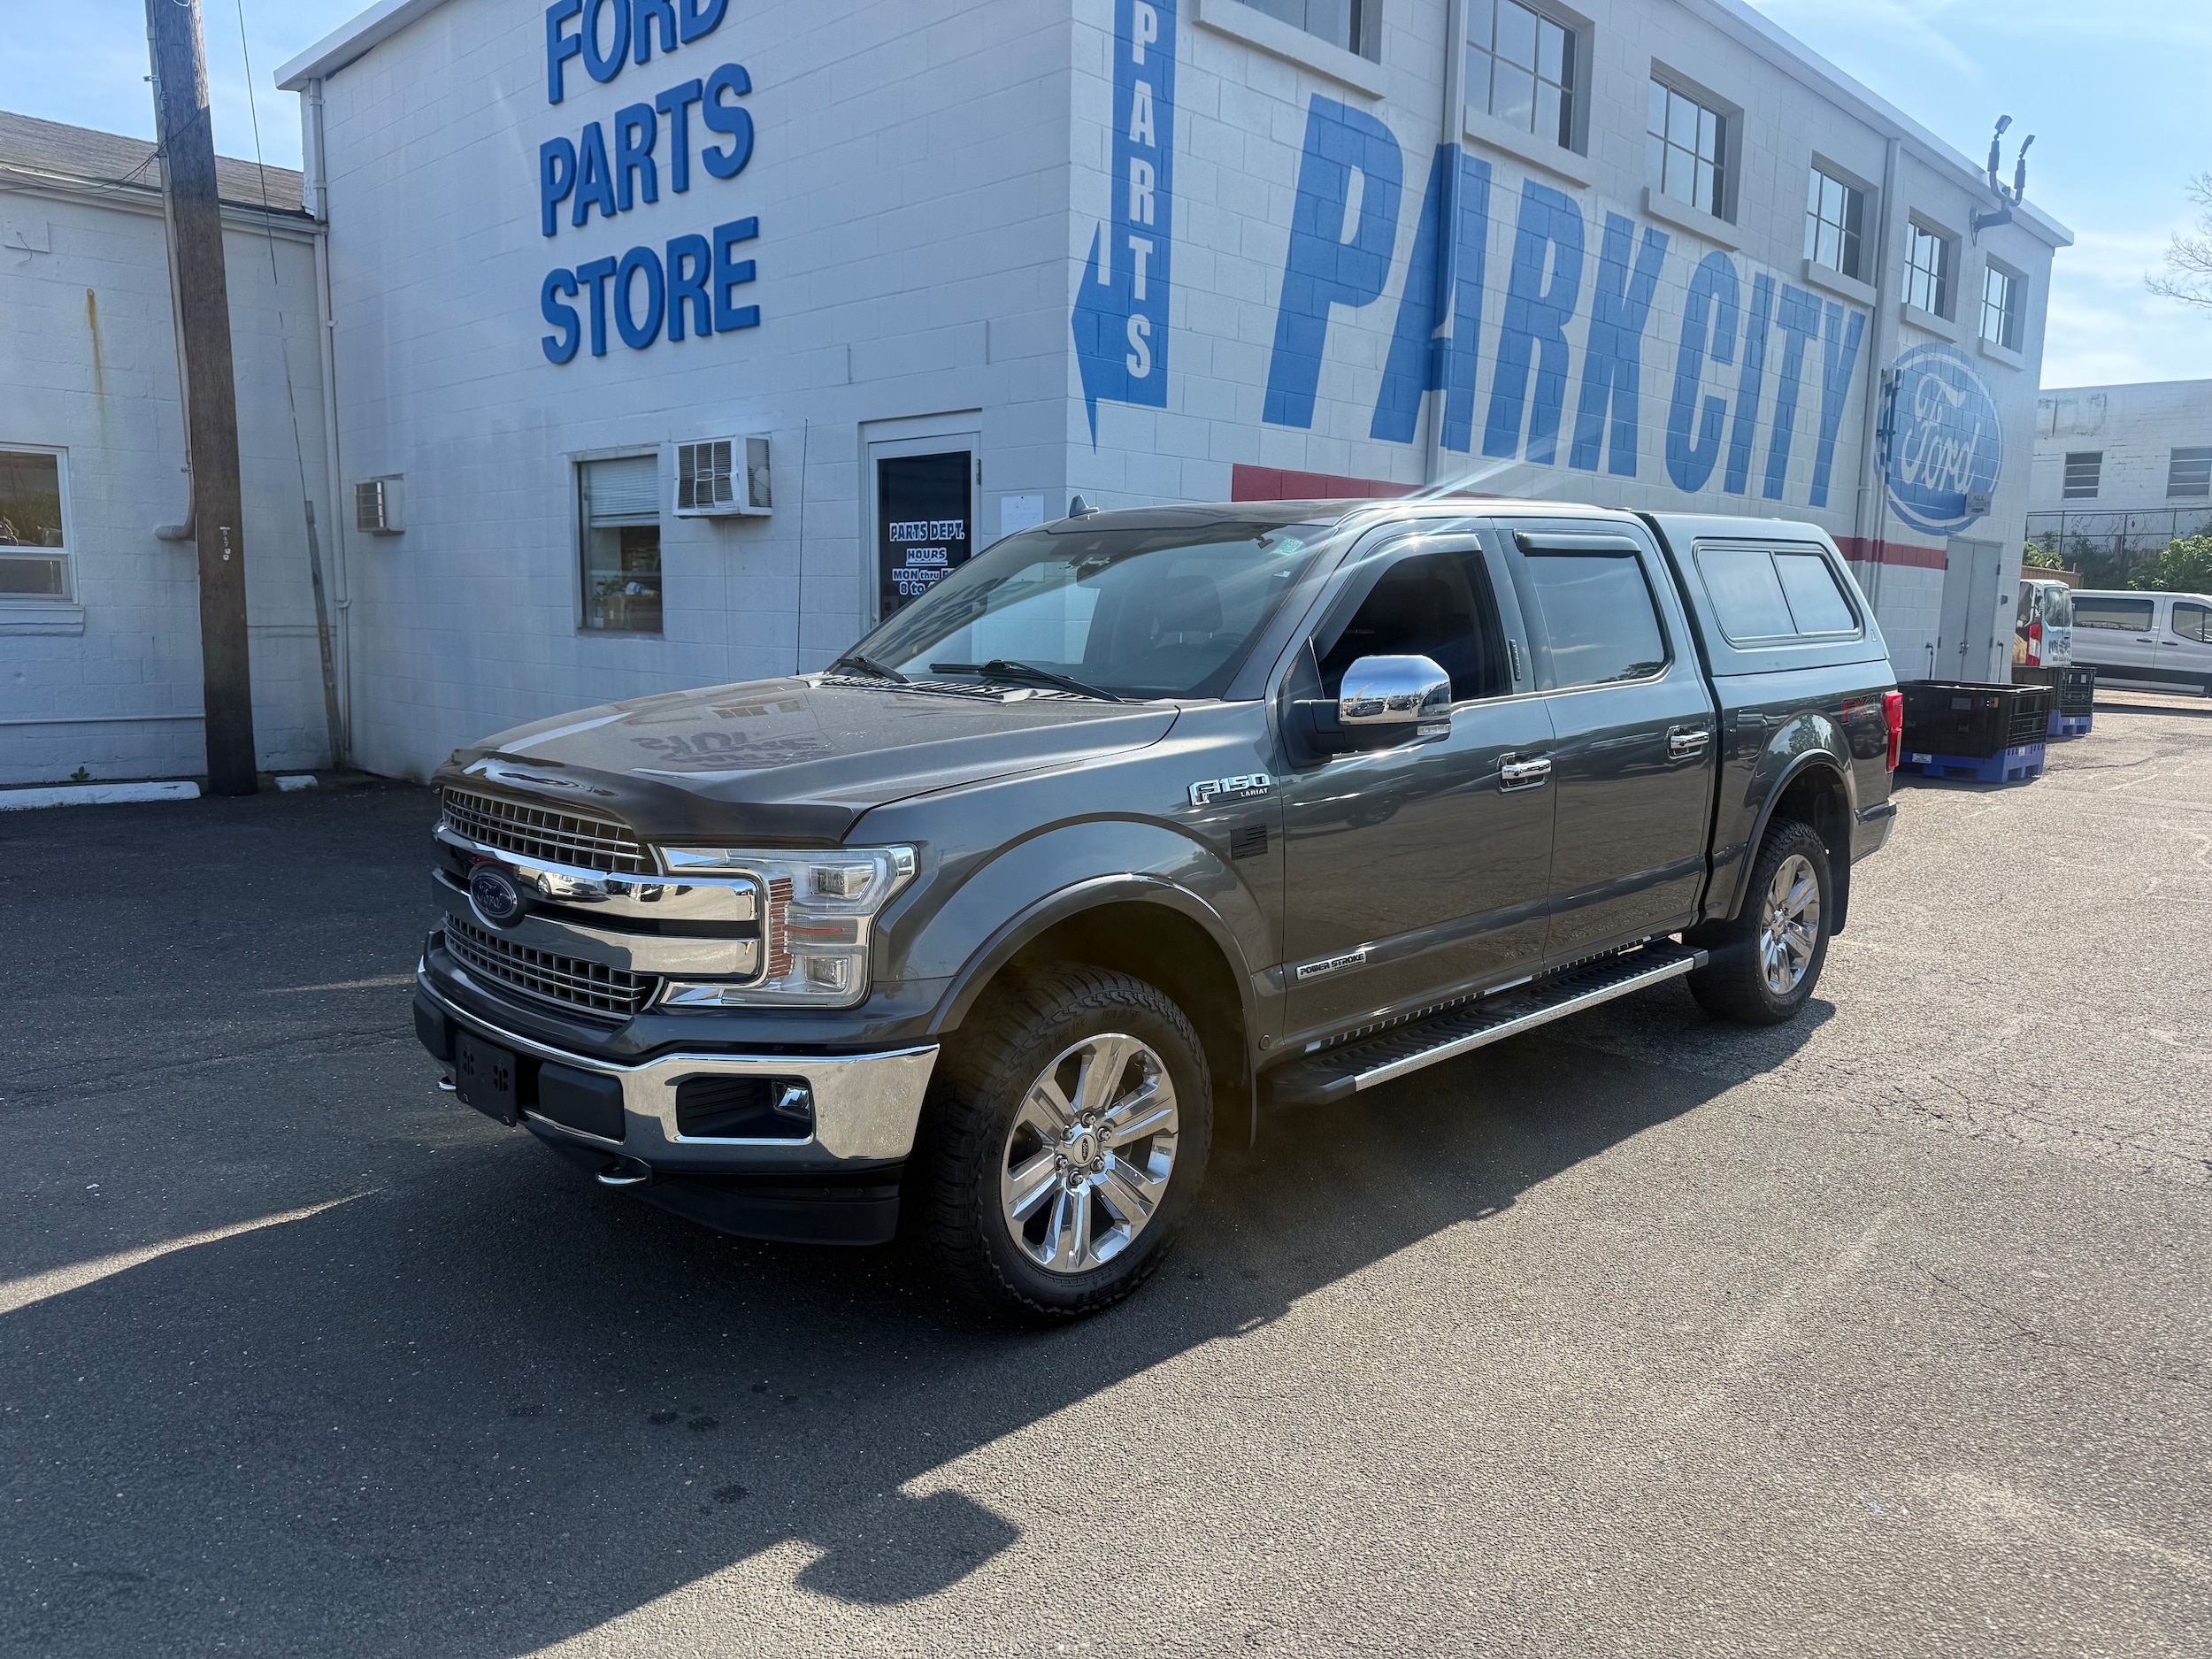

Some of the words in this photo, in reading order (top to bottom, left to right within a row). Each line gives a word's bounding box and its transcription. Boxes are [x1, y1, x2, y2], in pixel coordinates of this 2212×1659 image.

[539, 63, 755, 237] PARTS
[1126, 0, 1157, 379] PARTS
[541, 216, 760, 365] STORE
[1262, 93, 1670, 479] PARK
[1664, 250, 1866, 508] CITY
[1901, 373, 1981, 495] Ford
[889, 521, 928, 541] PARTS
[930, 519, 965, 541] DEPT.
[907, 548, 947, 561] HOURS
[893, 568, 918, 580] MON
[920, 570, 940, 580] thru
[900, 581, 908, 595] 8
[910, 581, 926, 595] to
[1841, 694, 1880, 725] FX4
[1240, 787, 1269, 797] LARIAT
[476, 880, 511, 910] Ford
[1300, 963, 1330, 976] POWER
[1331, 953, 1364, 968] STROKE
